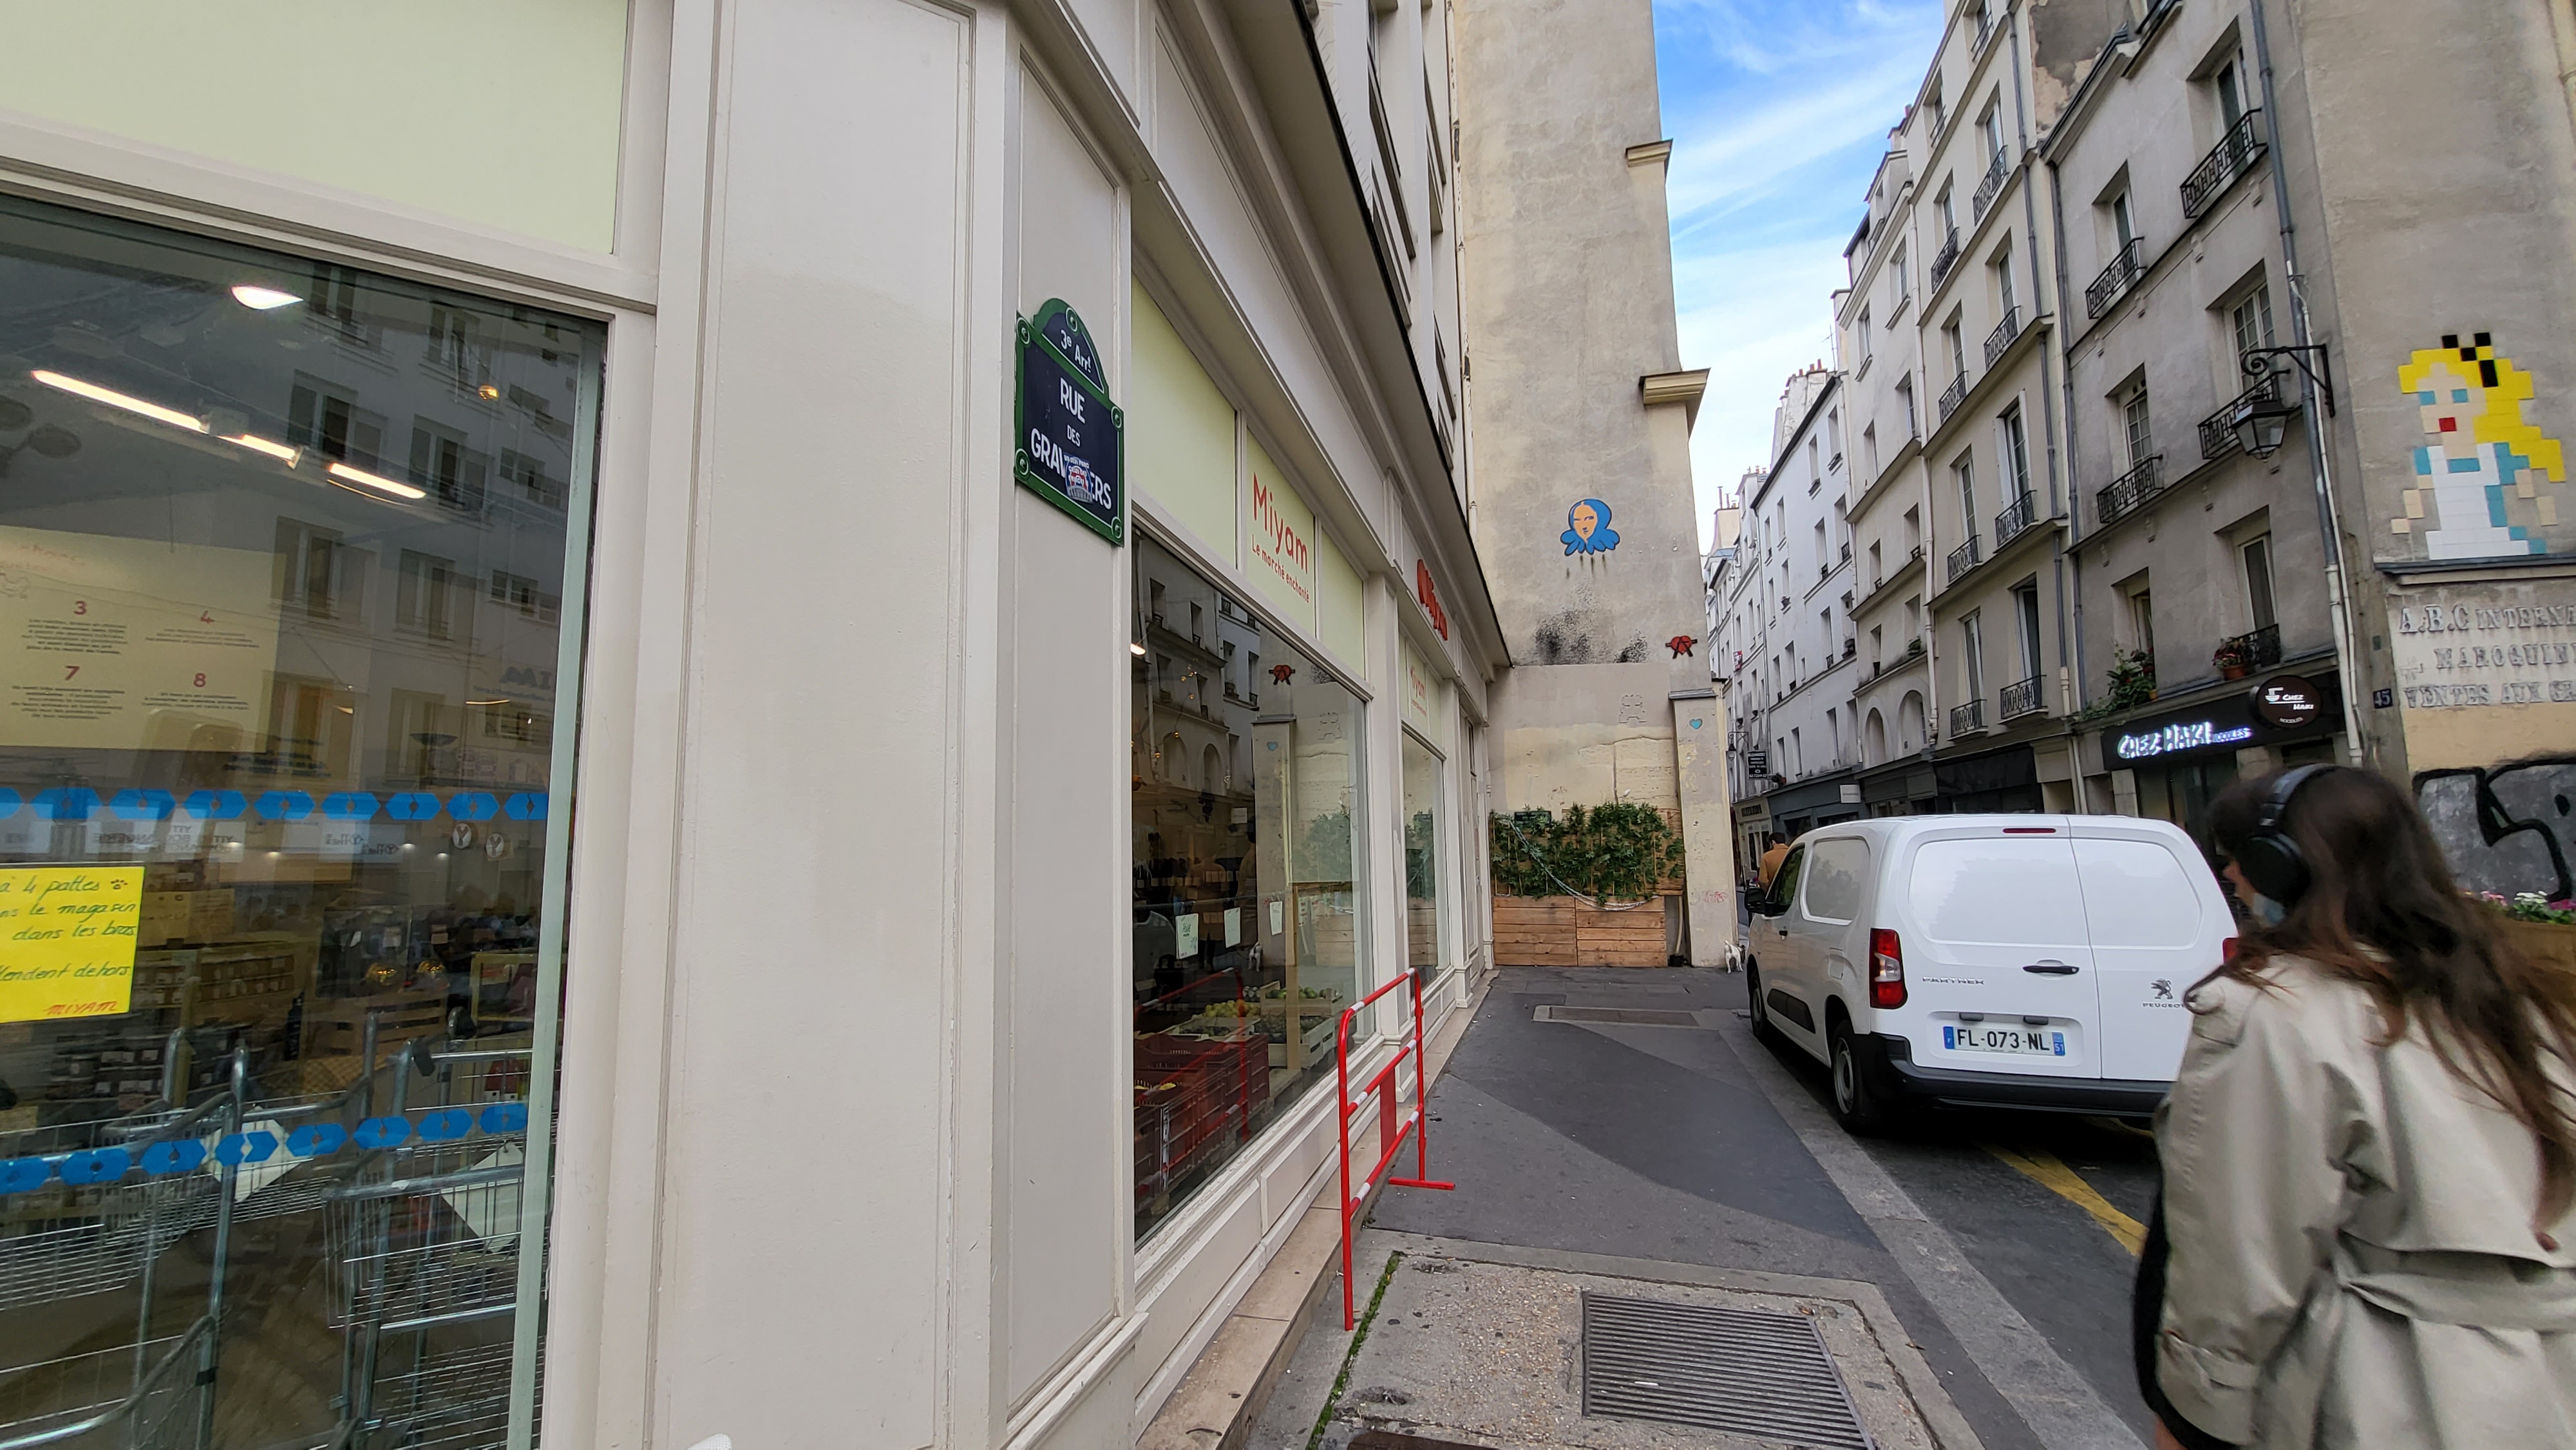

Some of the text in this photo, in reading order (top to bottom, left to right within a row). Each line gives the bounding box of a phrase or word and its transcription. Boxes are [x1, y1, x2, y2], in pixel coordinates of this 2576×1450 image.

[1060, 377, 1086, 424] RUE
[1067, 424, 1081, 447] DES
[1253, 471, 1308, 574] Miyam
[1252, 534, 1309, 604] Le marché enchanté
[73, 601, 87, 616] 3
[200, 610, 214, 625] 4
[65, 665, 80, 681] 7
[193, 672, 206, 688] 8
[2374, 690, 2391, 707] 45
[2403, 684, 2490, 708] VENTES
[2117, 733, 2163, 759] CHEZ
[2163, 721, 2213, 751] HAKI
[23, 875, 37, 894] 4
[38, 875, 100, 902] pattes
[30, 903, 48, 916] le
[58, 903, 137, 923] magasin
[12, 920, 137, 940] dans les bras
[1922, 976, 1984, 985] PARTNER
[1956, 1029, 2050, 1051] FL-073-NL
[2054, 1043, 2064, 1052] 51
